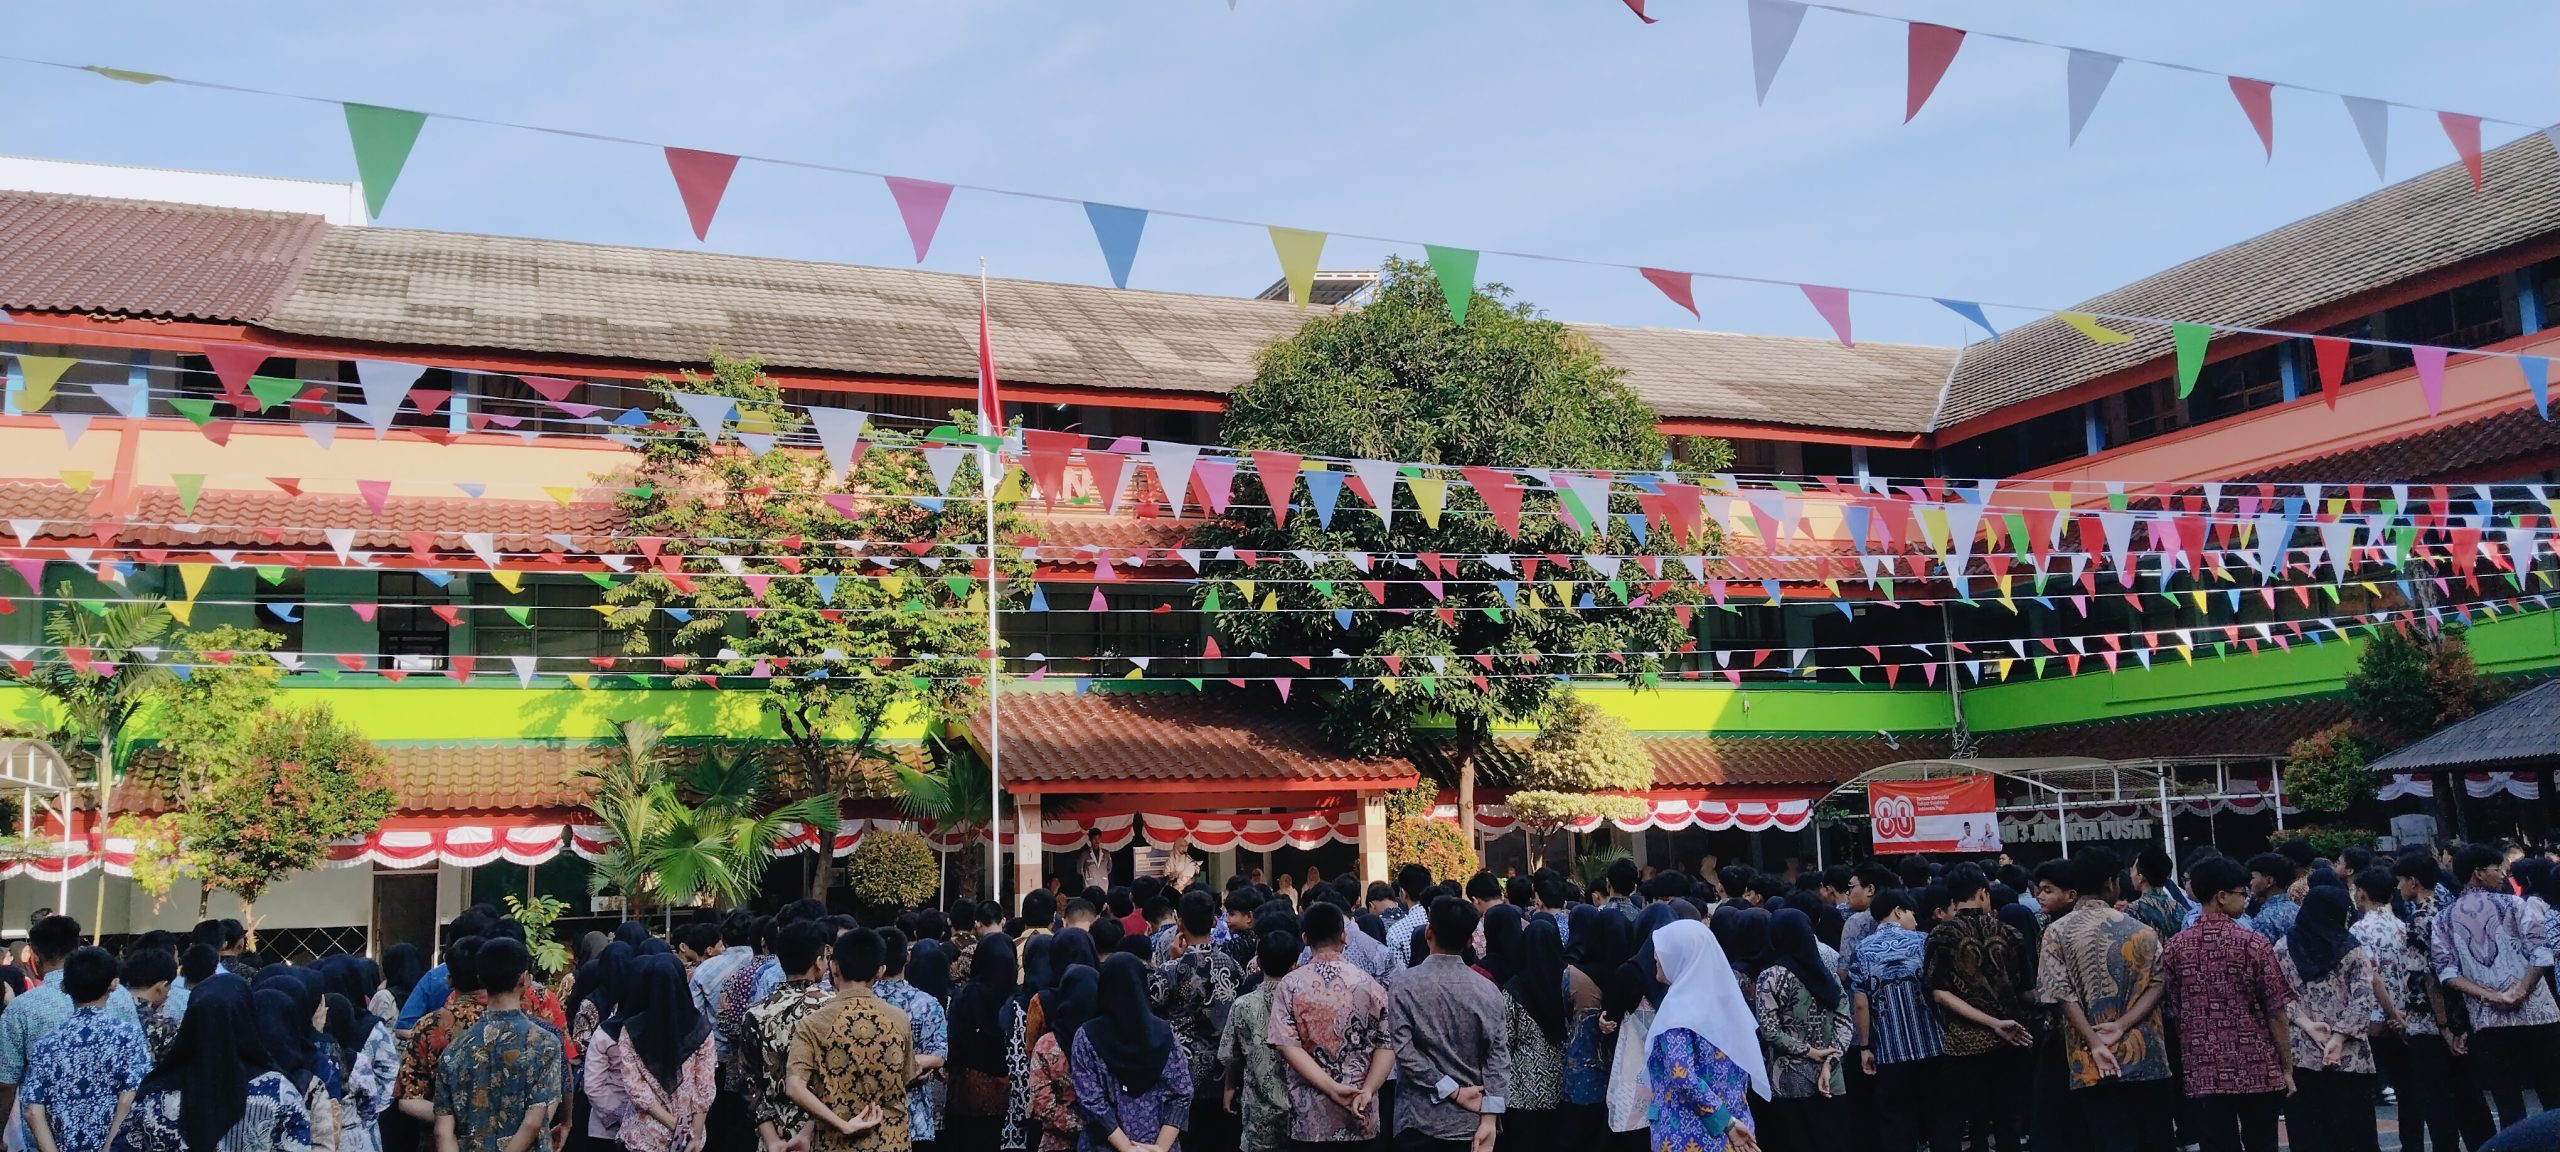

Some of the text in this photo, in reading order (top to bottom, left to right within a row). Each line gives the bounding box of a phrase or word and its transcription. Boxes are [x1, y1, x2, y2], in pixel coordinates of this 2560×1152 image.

[1875, 795, 1915, 839] 80
[2018, 823, 2029, 843] 3
[2101, 819, 2152, 840] PUSAT
